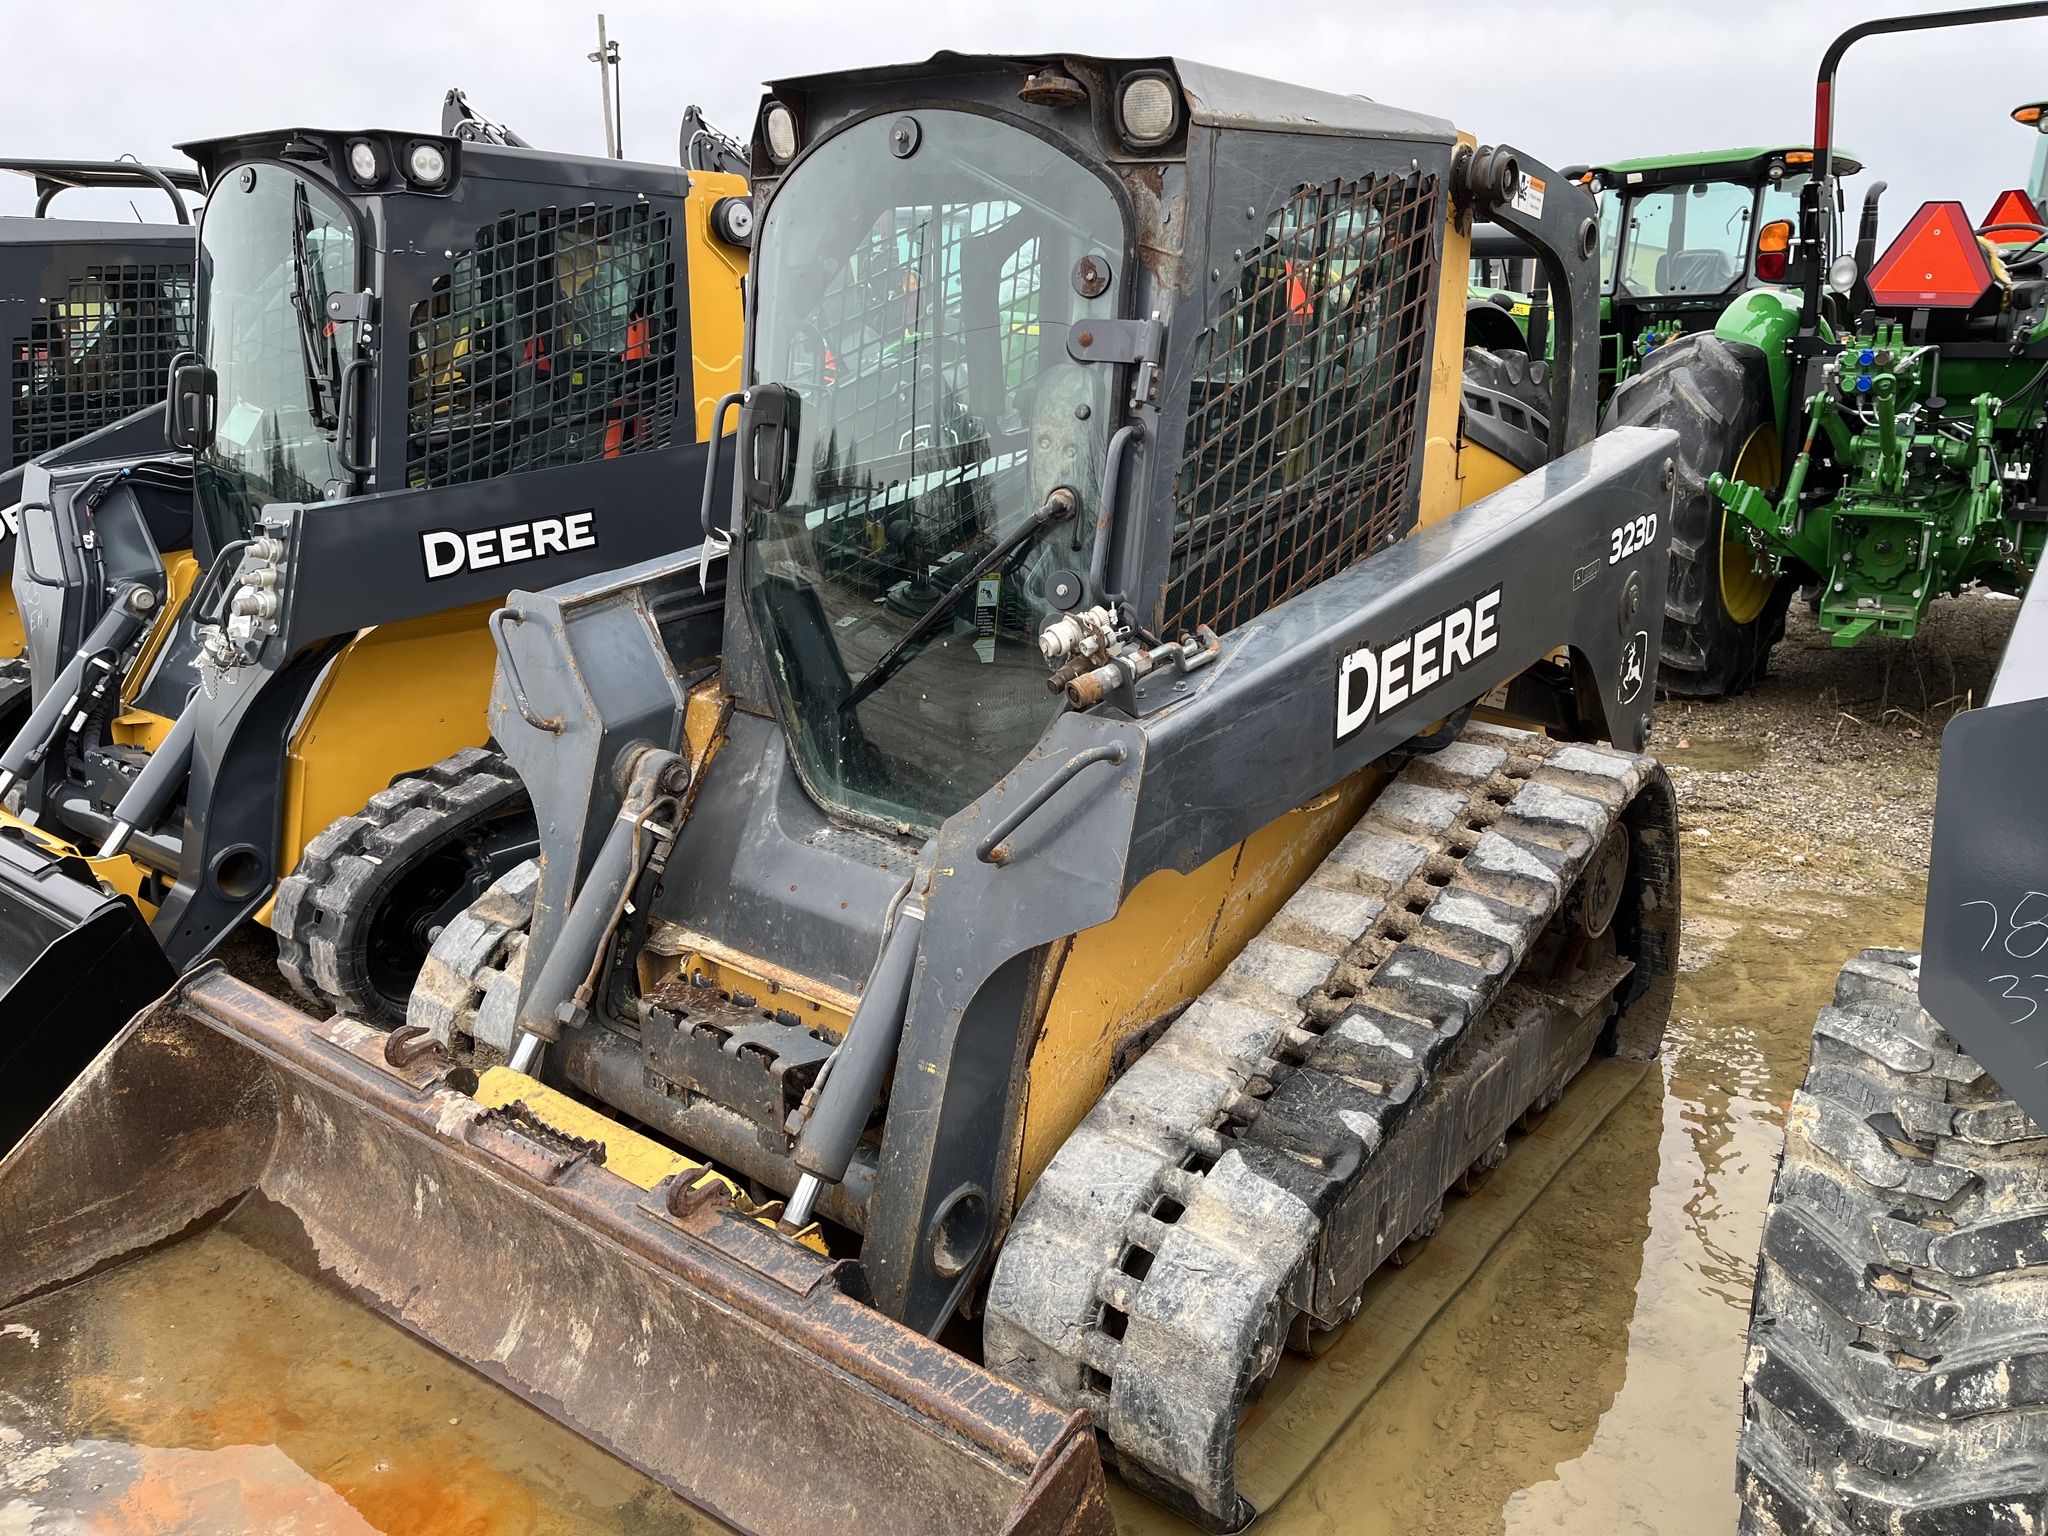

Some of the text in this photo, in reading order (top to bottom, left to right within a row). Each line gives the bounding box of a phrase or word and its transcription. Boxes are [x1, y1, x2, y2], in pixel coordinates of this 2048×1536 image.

[423, 512, 596, 578] DEERE
[1609, 513, 1657, 565] 323D
[1336, 588, 1501, 740] DEERE
